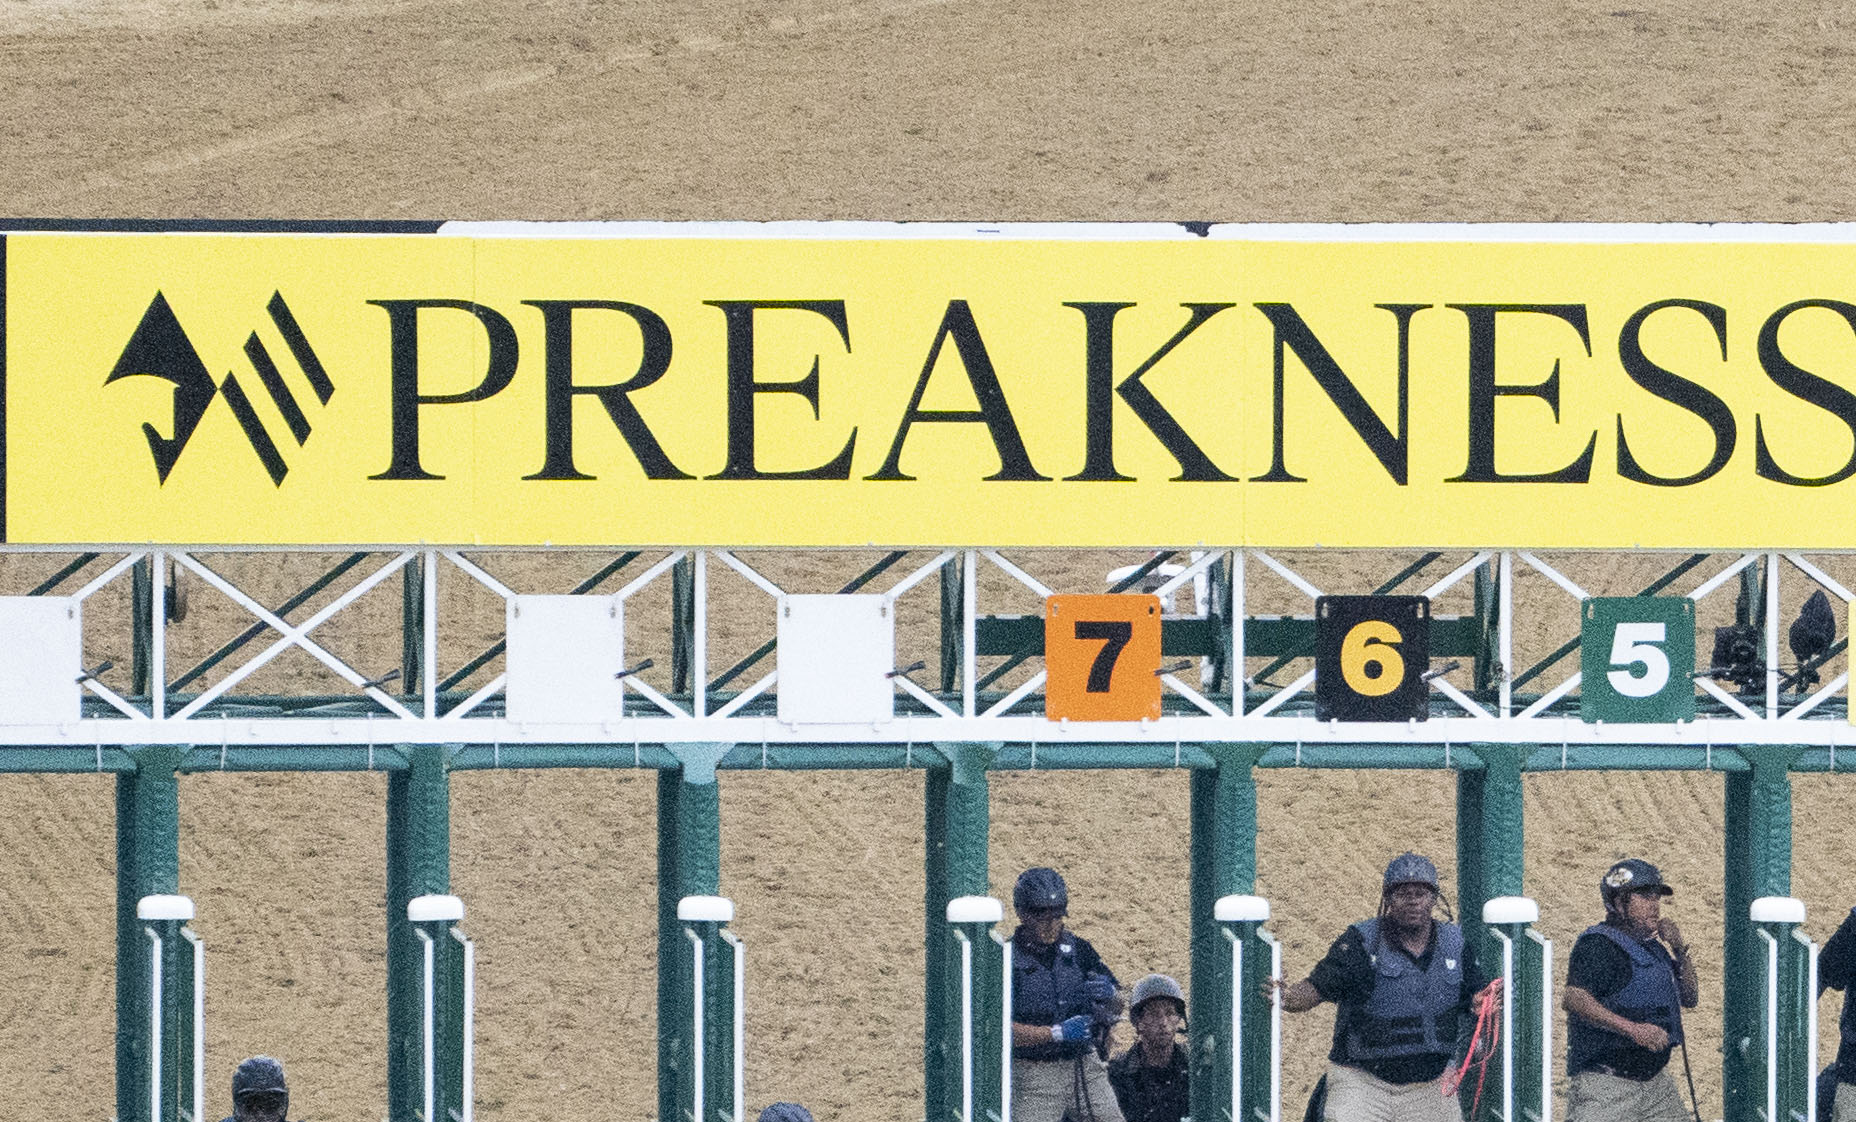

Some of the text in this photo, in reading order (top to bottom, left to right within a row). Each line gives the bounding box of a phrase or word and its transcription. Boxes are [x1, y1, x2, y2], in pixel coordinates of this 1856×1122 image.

[1073, 620, 1133, 694] 7
[1339, 619, 1406, 698] 6
[1606, 621, 1671, 698] 5
